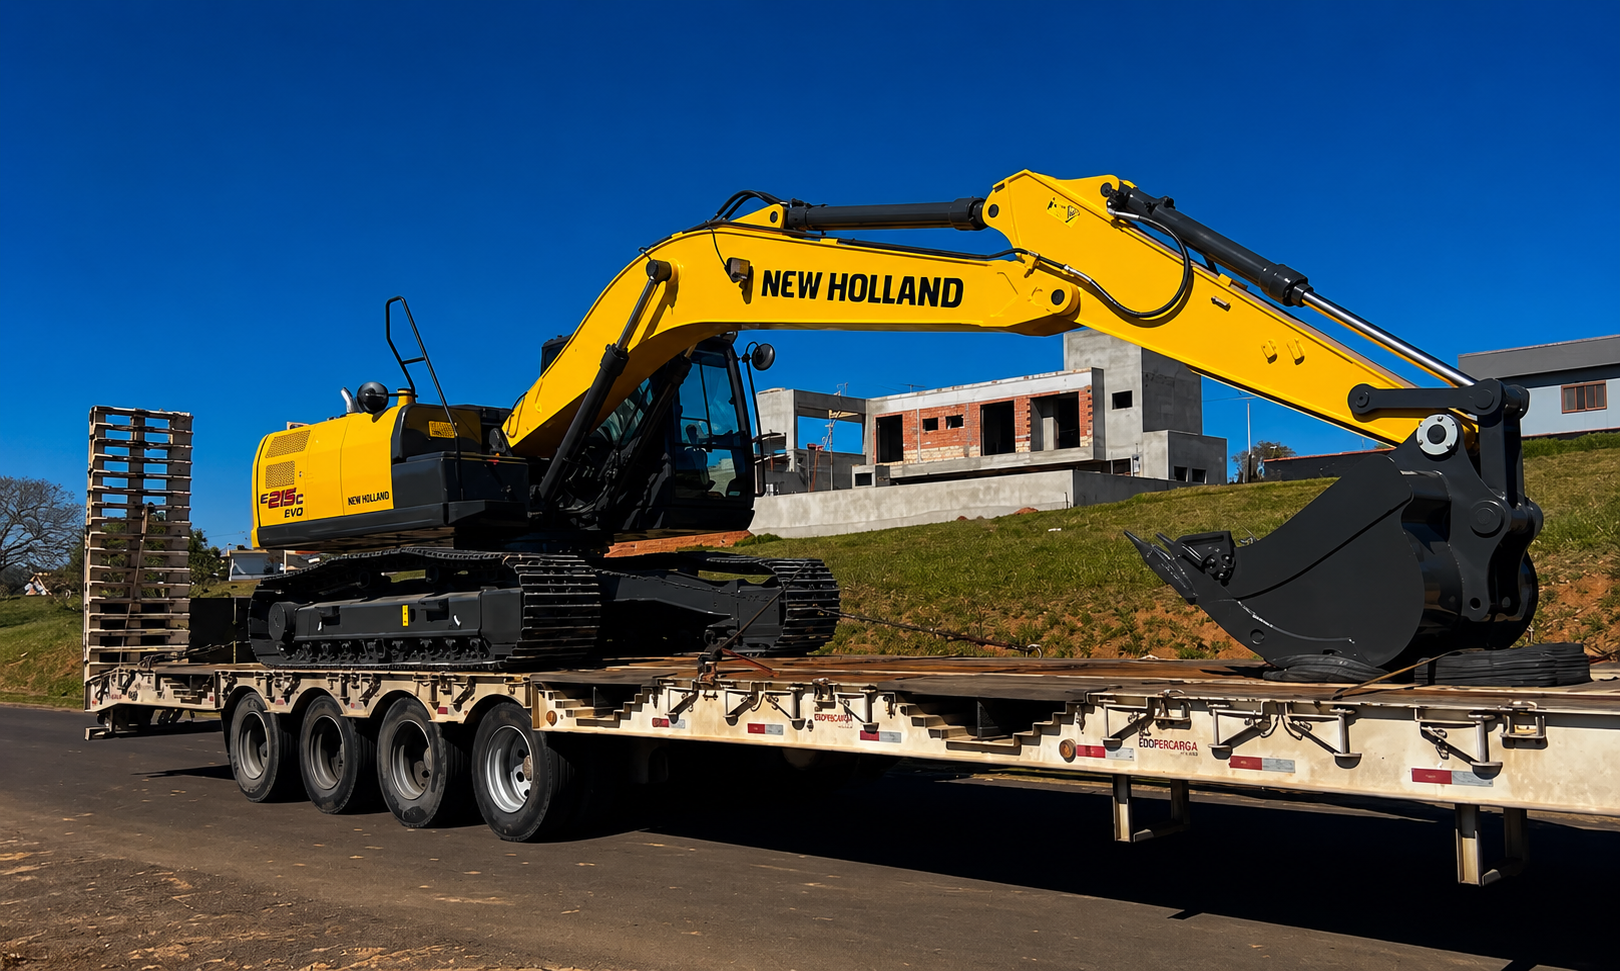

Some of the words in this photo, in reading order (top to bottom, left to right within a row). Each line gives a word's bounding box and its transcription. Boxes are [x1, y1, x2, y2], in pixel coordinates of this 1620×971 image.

[761, 270, 823, 300] NEW
[827, 272, 964, 308] HOLLAND
[348, 495, 361, 506] NEW
[362, 491, 389, 504] HOLLAND
[284, 507, 303, 518] EVO
